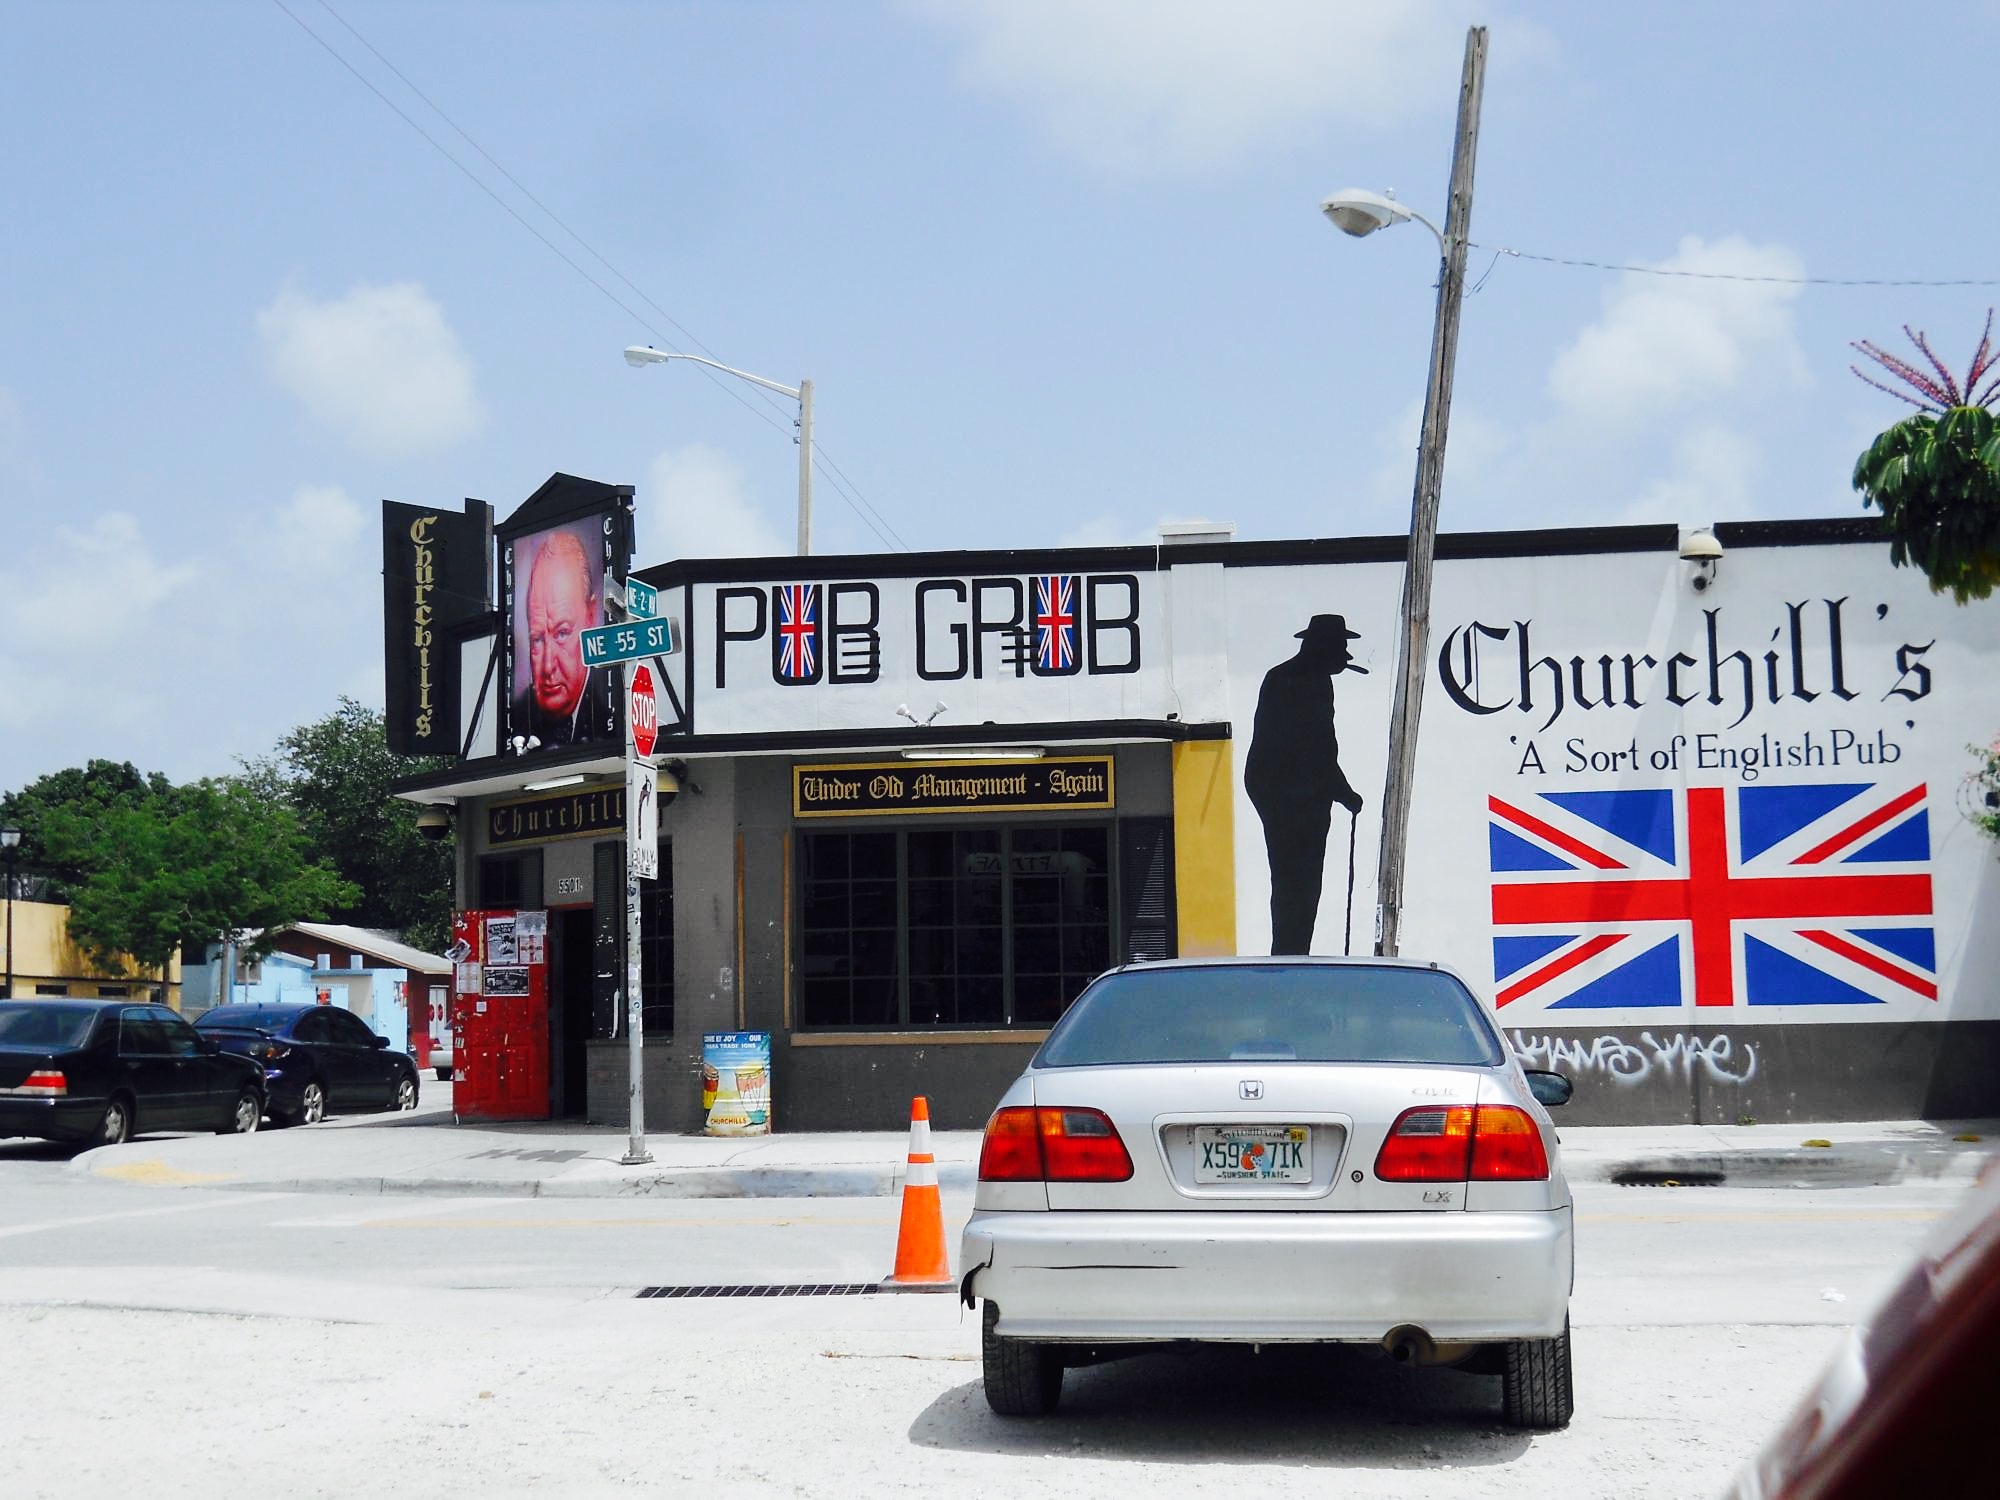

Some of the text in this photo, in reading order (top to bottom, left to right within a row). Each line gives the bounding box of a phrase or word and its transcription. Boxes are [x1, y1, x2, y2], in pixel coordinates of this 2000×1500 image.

[410, 515, 438, 737] Churchill's
[586, 625, 664, 657] NE 55 ST
[715, 574, 1140, 688] PUB GRUB
[1438, 596, 1937, 733] Churchill's
[632, 692, 655, 730] STOP
[1565, 738, 1639, 772] Sort
[1650, 735, 1686, 770] of
[1697, 732, 1825, 781] English
[803, 775, 861, 801] Under
[869, 774, 903, 799] Old
[911, 772, 1027, 801] Management
[1049, 767, 1104, 797] Again
[493, 791, 622, 837] Churchill
[710, 1117, 747, 1126] CHURCHILLS
[1202, 1142, 1304, 1169] X59 7IK
[1423, 1191, 1452, 1203] LX
